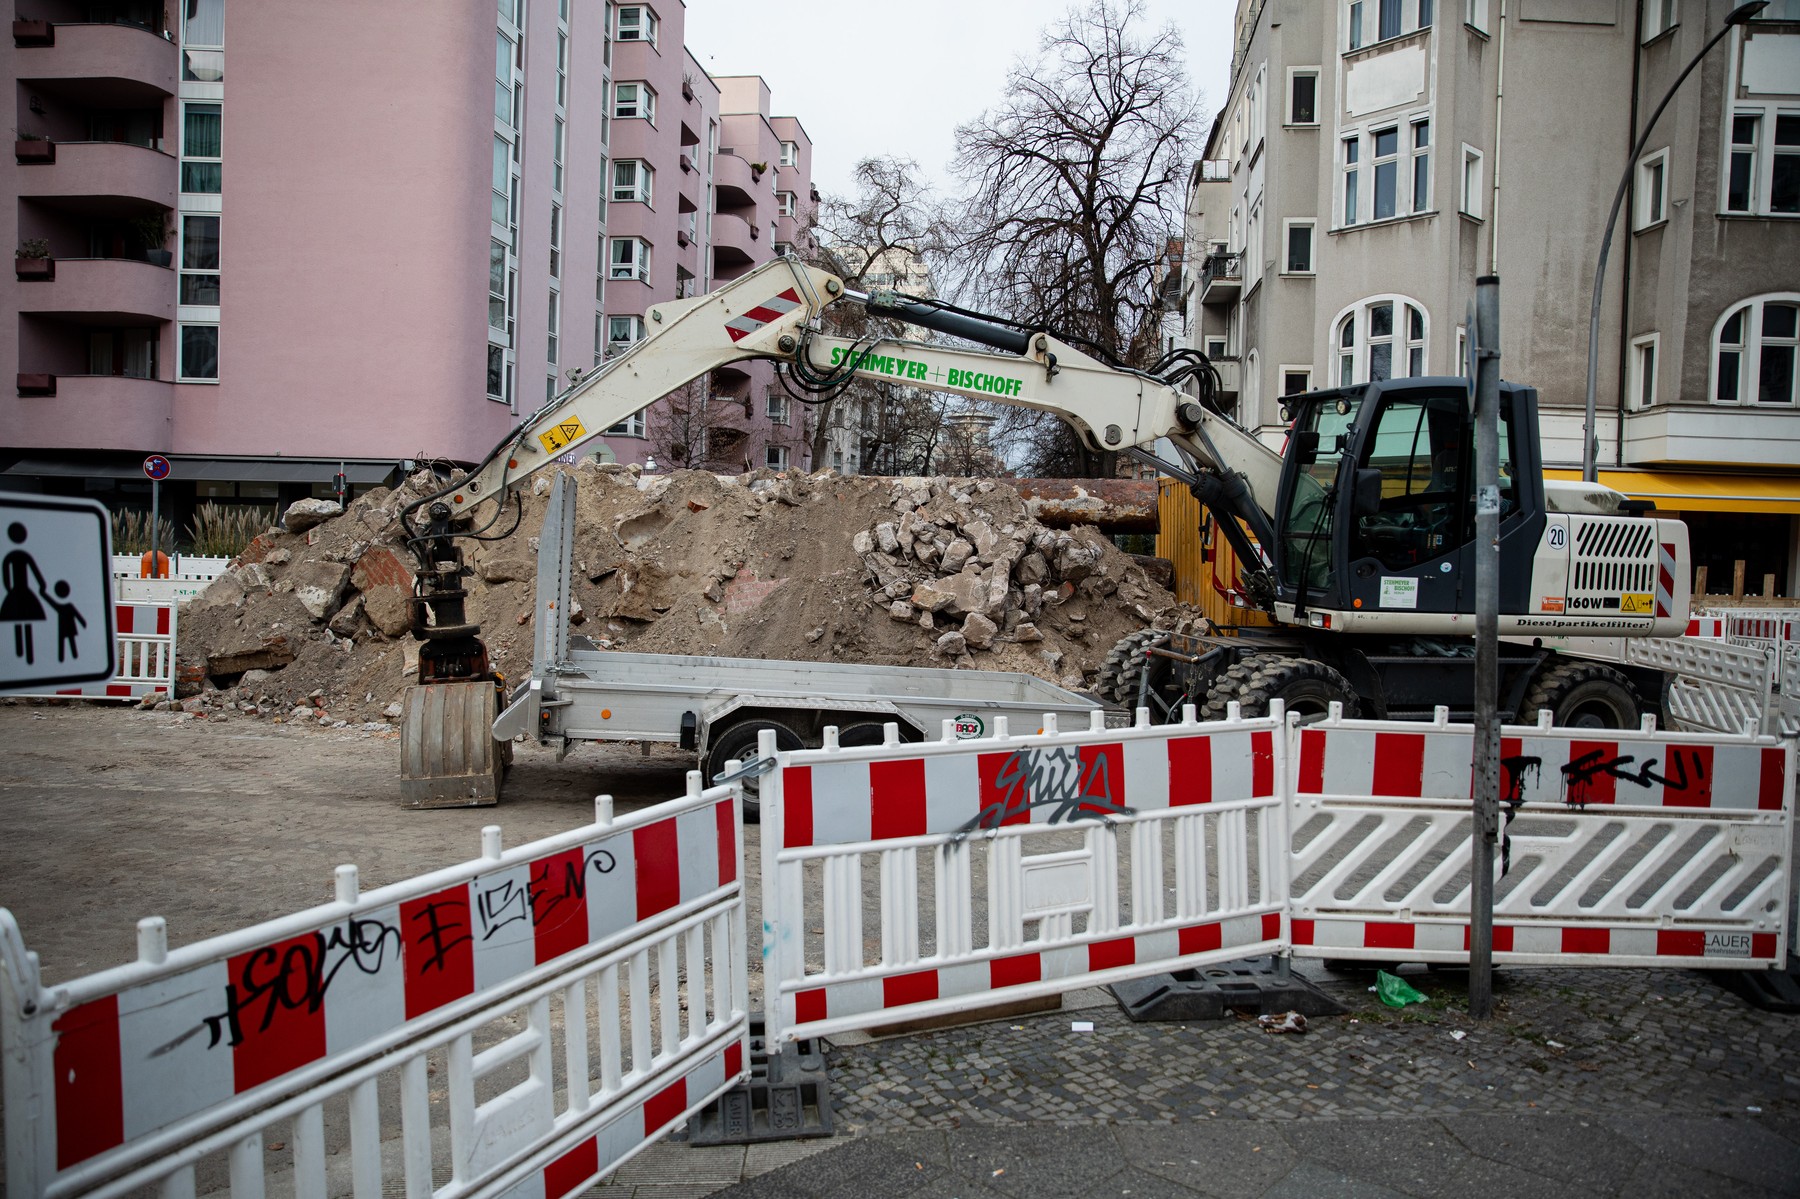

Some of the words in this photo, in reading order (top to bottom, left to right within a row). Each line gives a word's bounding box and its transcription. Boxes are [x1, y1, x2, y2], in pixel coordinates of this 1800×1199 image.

[947, 368, 1023, 396] BISCHOFF
[1550, 529, 1564, 546] 20
[1567, 597, 1603, 609] 160W
[1516, 619, 1649, 629] Dieselpartikelfilter!
[1704, 934, 1750, 948] LAUER
